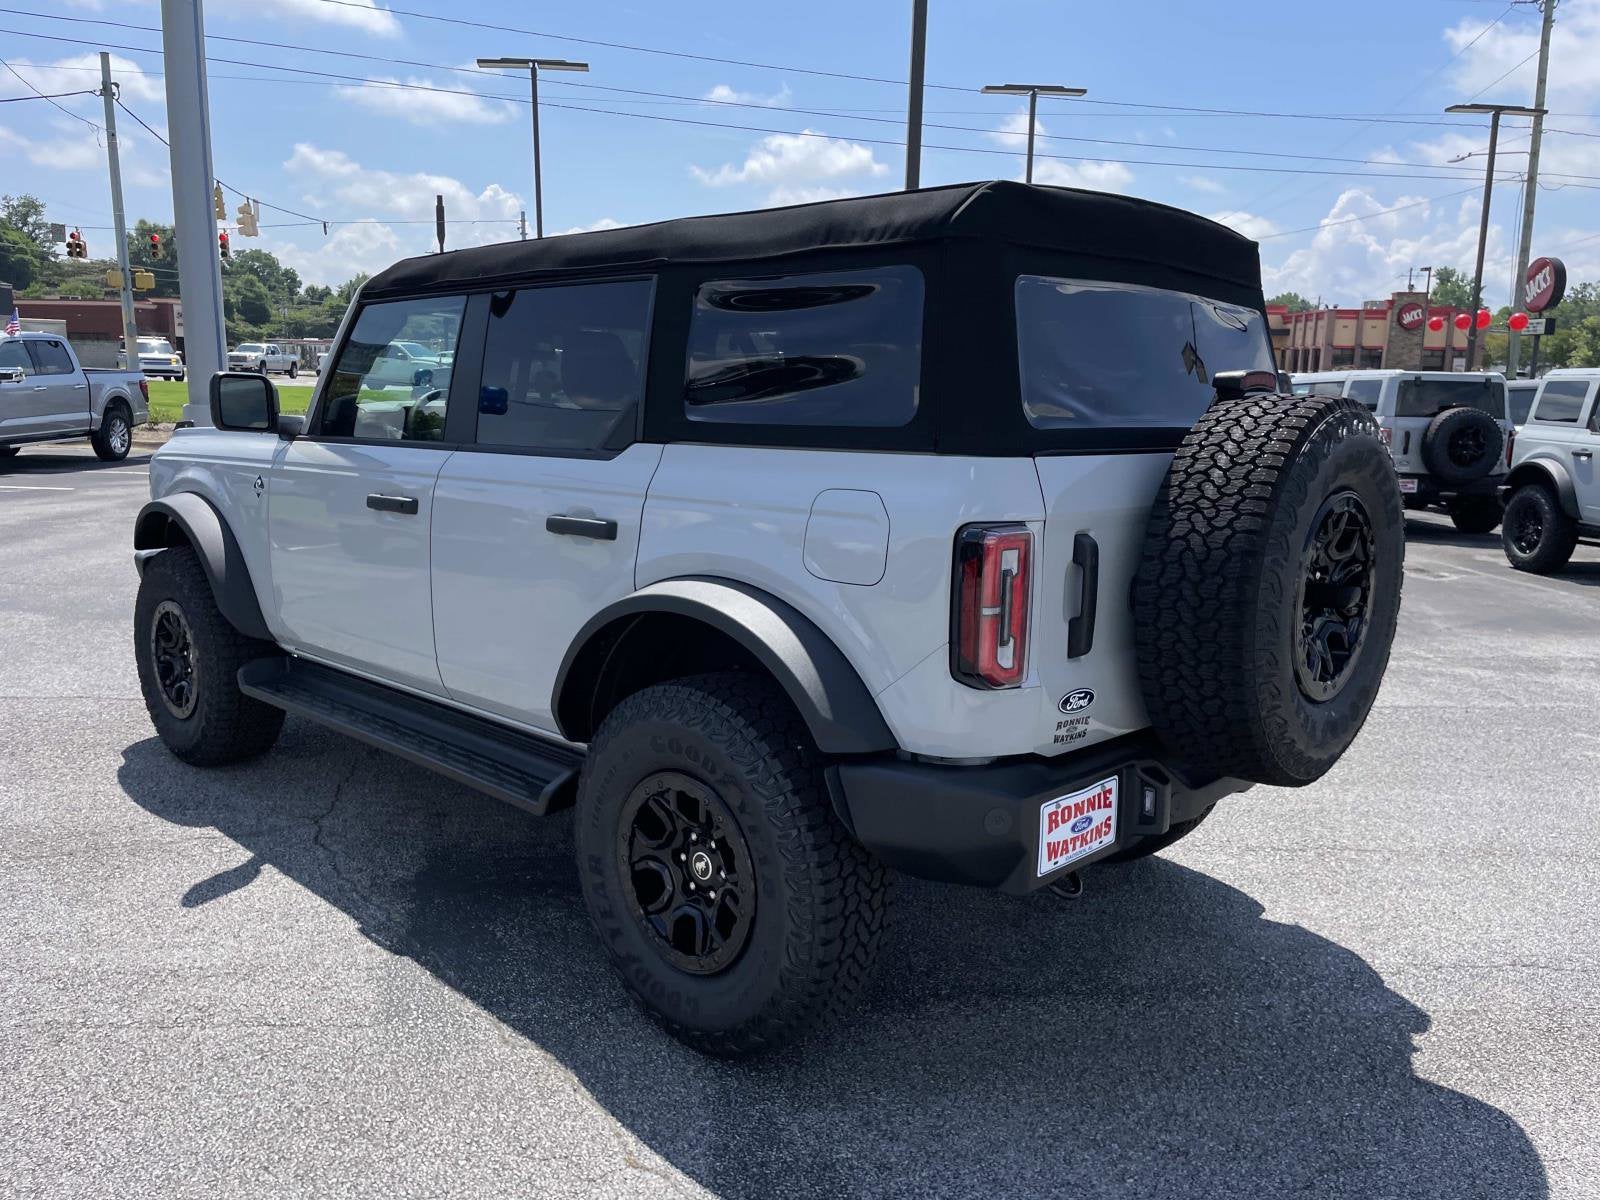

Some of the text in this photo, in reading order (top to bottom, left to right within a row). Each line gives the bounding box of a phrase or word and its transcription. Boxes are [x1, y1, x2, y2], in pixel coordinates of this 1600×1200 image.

[1066, 693, 1090, 710] Ford
[1056, 716, 1091, 731] RONNIE
[1054, 728, 1087, 744] WATKINS
[1047, 787, 1112, 835] RONNIE
[1046, 816, 1112, 862] WATKINS
